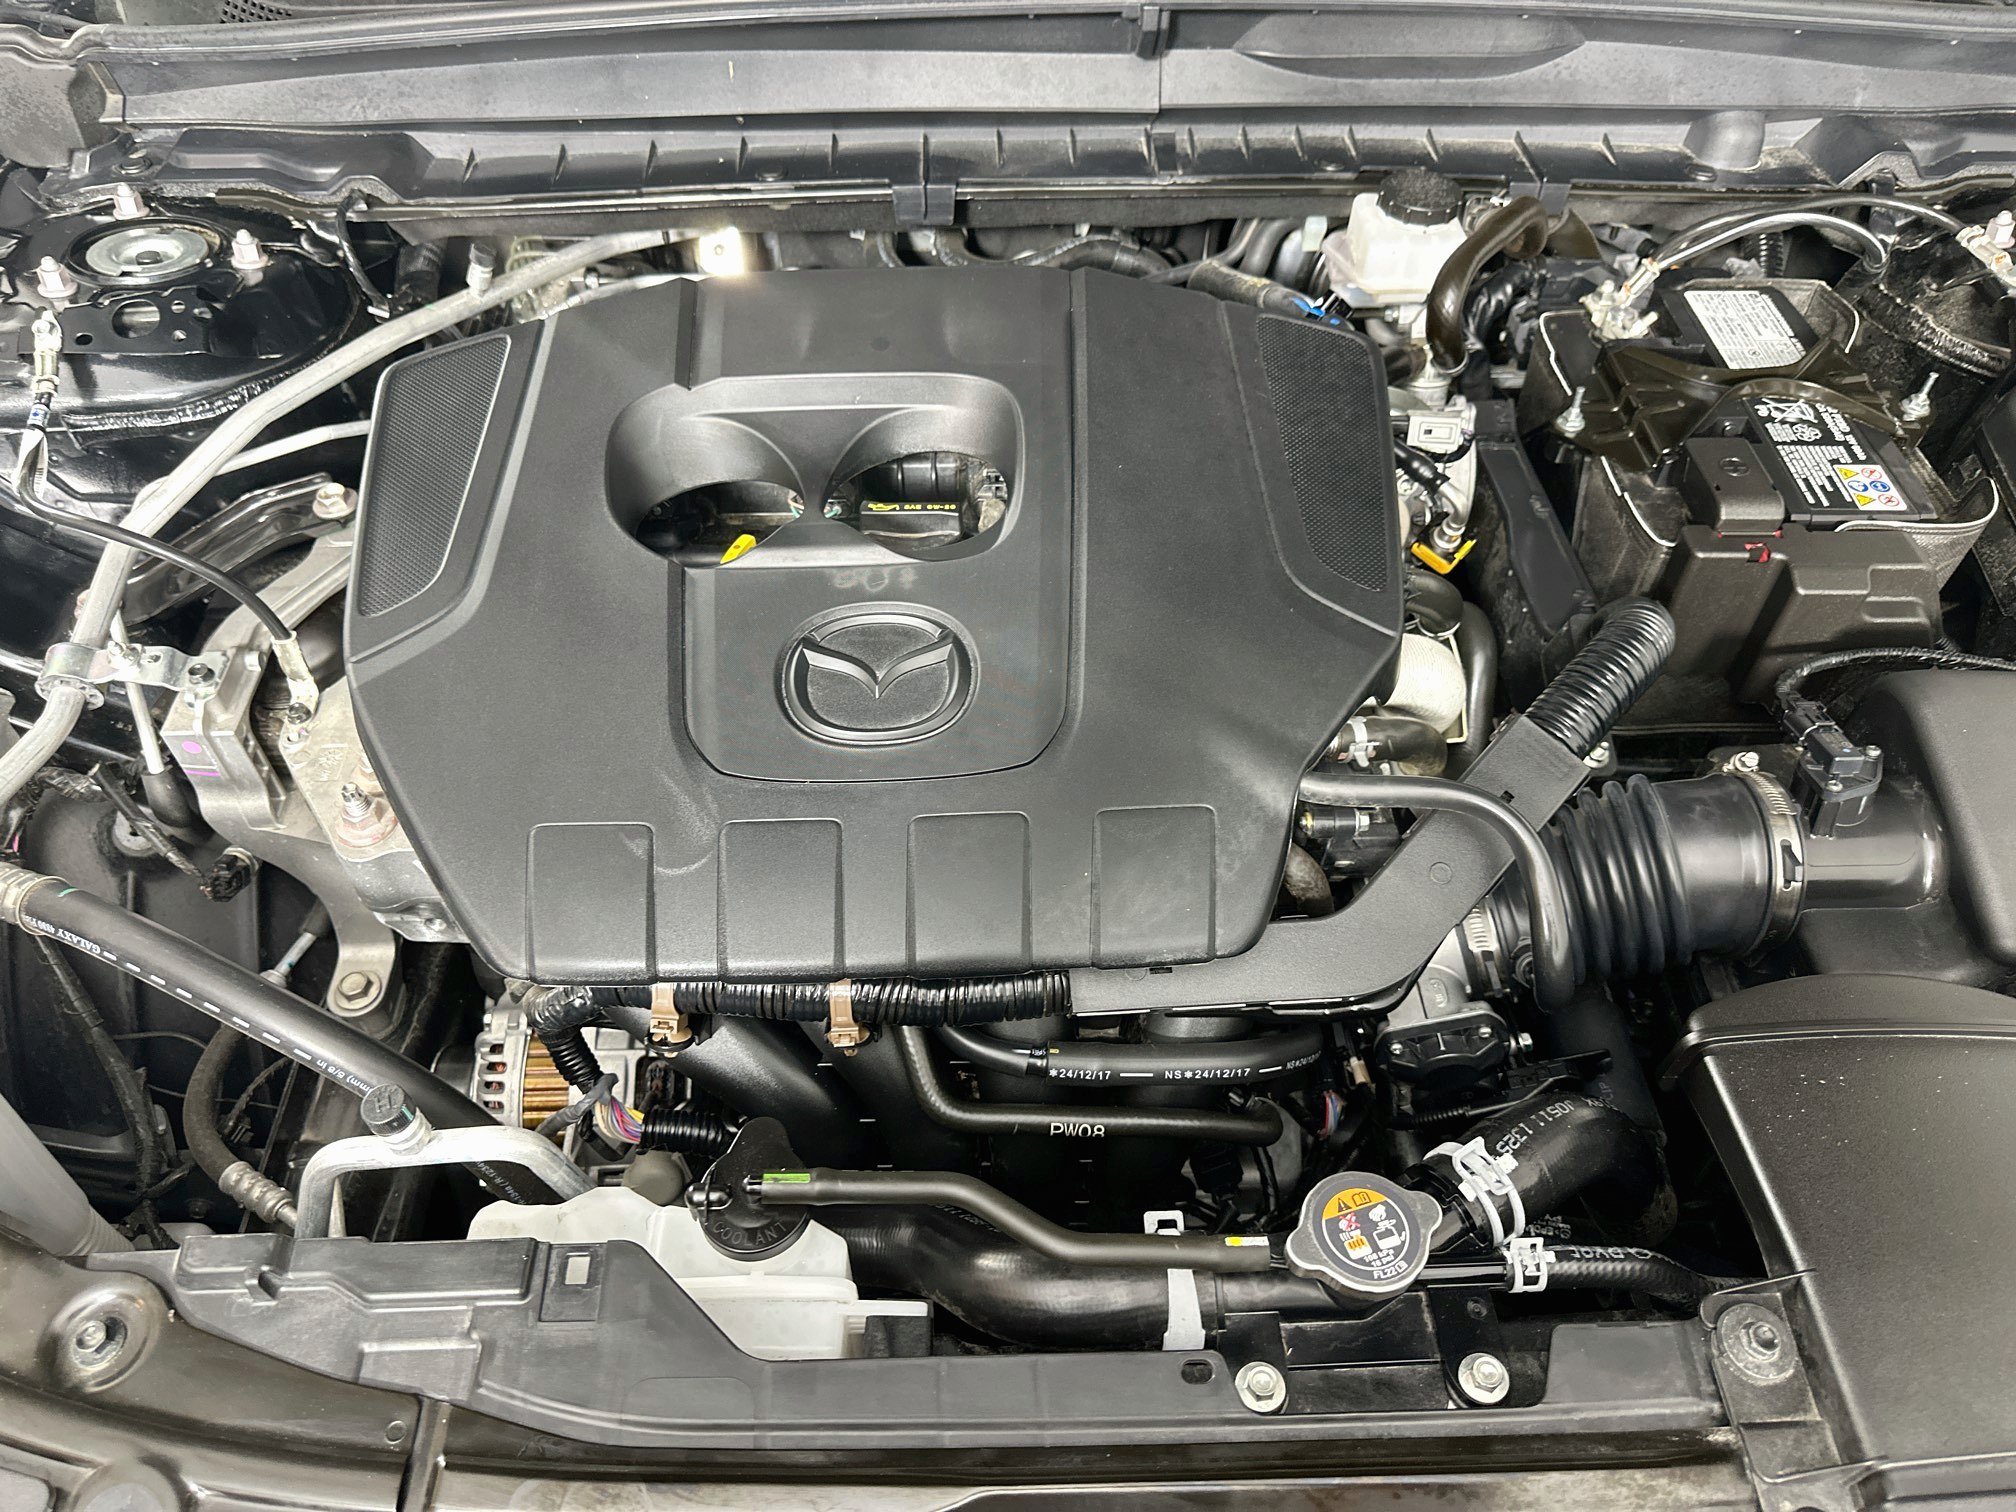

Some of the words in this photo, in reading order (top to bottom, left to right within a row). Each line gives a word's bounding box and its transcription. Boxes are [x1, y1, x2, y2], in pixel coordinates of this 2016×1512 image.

[56, 928, 101, 954] GALAXY
[713, 1221, 787, 1246] COOLANT
[1373, 1266, 1398, 1280] FL22
